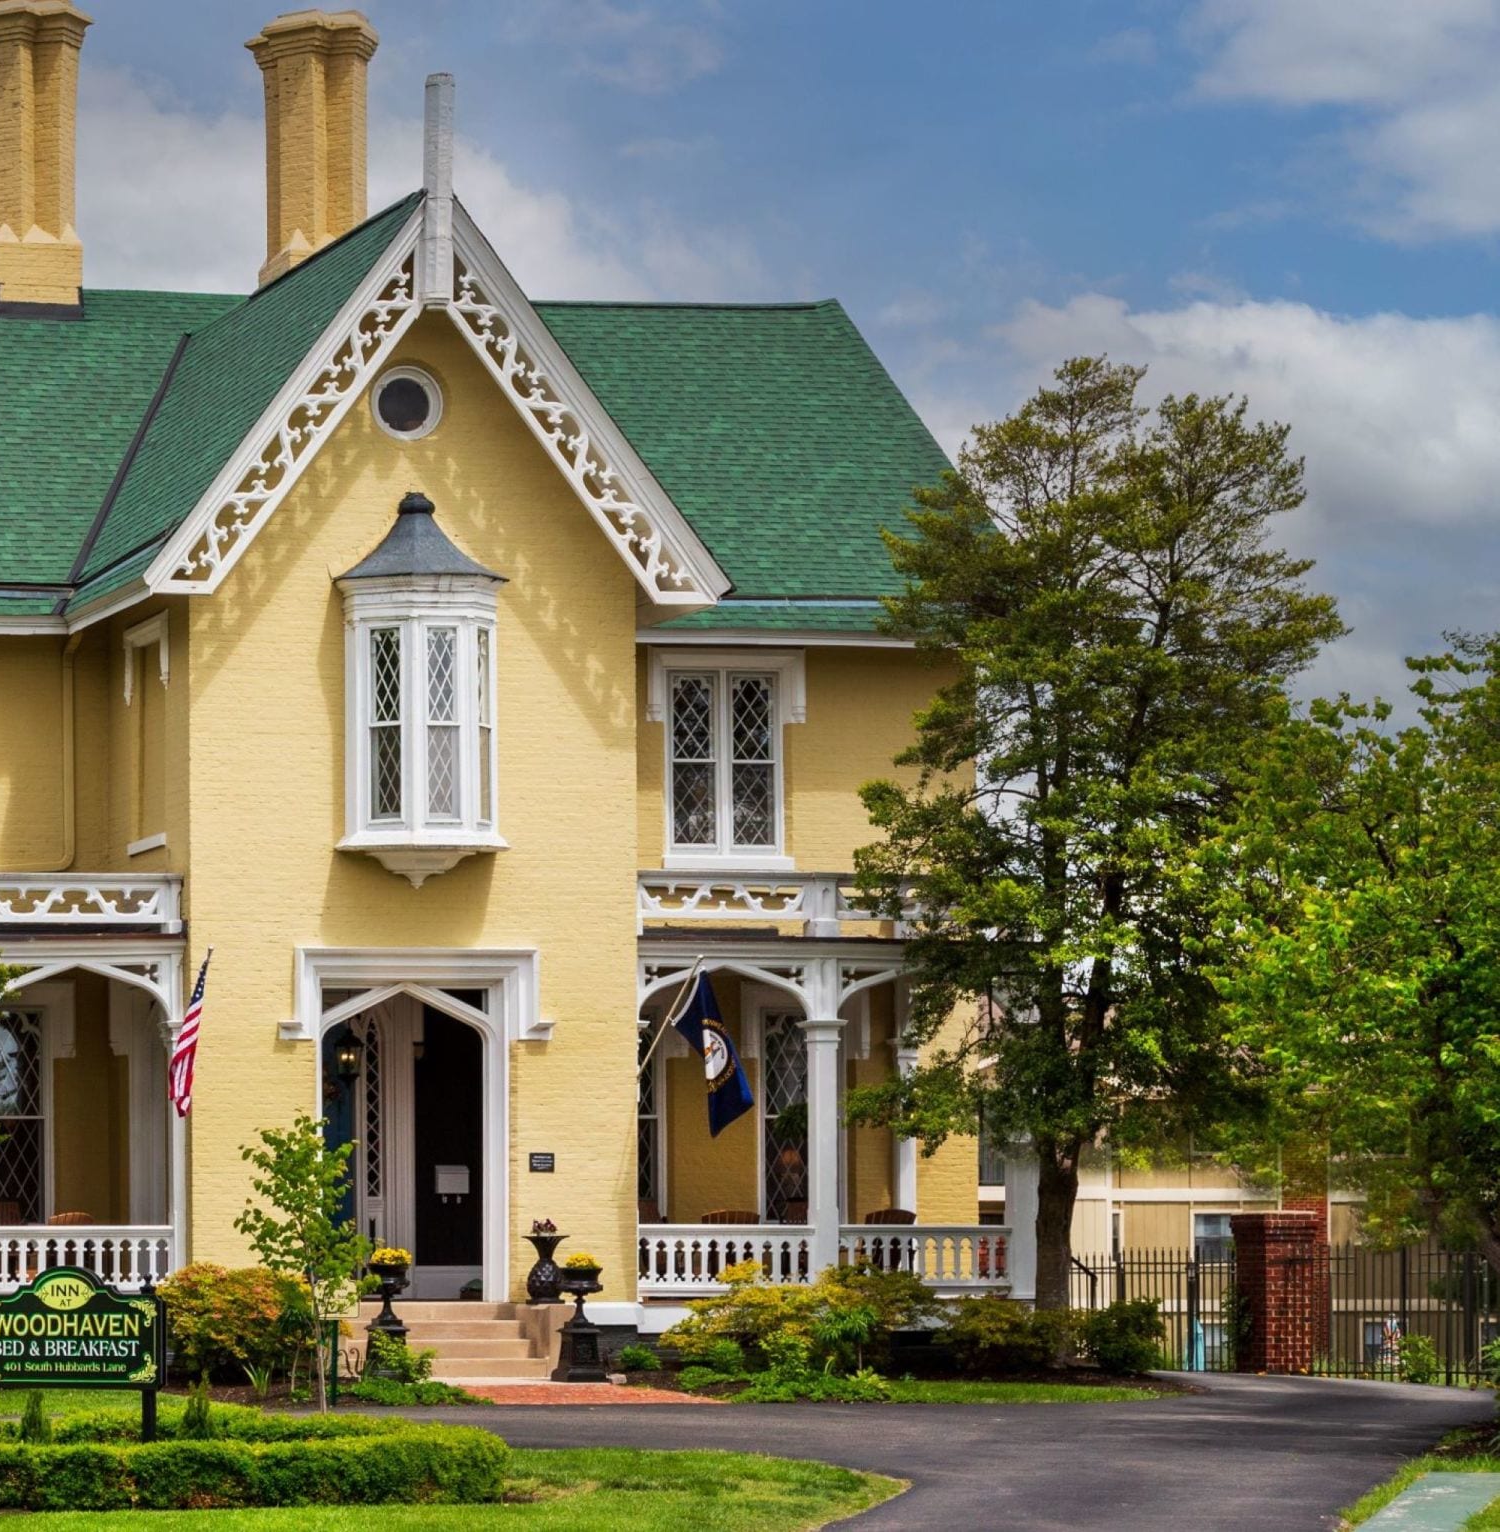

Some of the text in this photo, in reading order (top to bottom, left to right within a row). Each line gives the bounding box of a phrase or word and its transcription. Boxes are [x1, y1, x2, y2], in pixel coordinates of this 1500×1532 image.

[51, 1285, 79, 1297] INN
[59, 1299, 71, 1307] AT
[29, 1340, 41, 1357] &
[45, 1340, 140, 1357] BREAKFAST
[3, 1362, 127, 1373] 401 South Hubbards Lane
